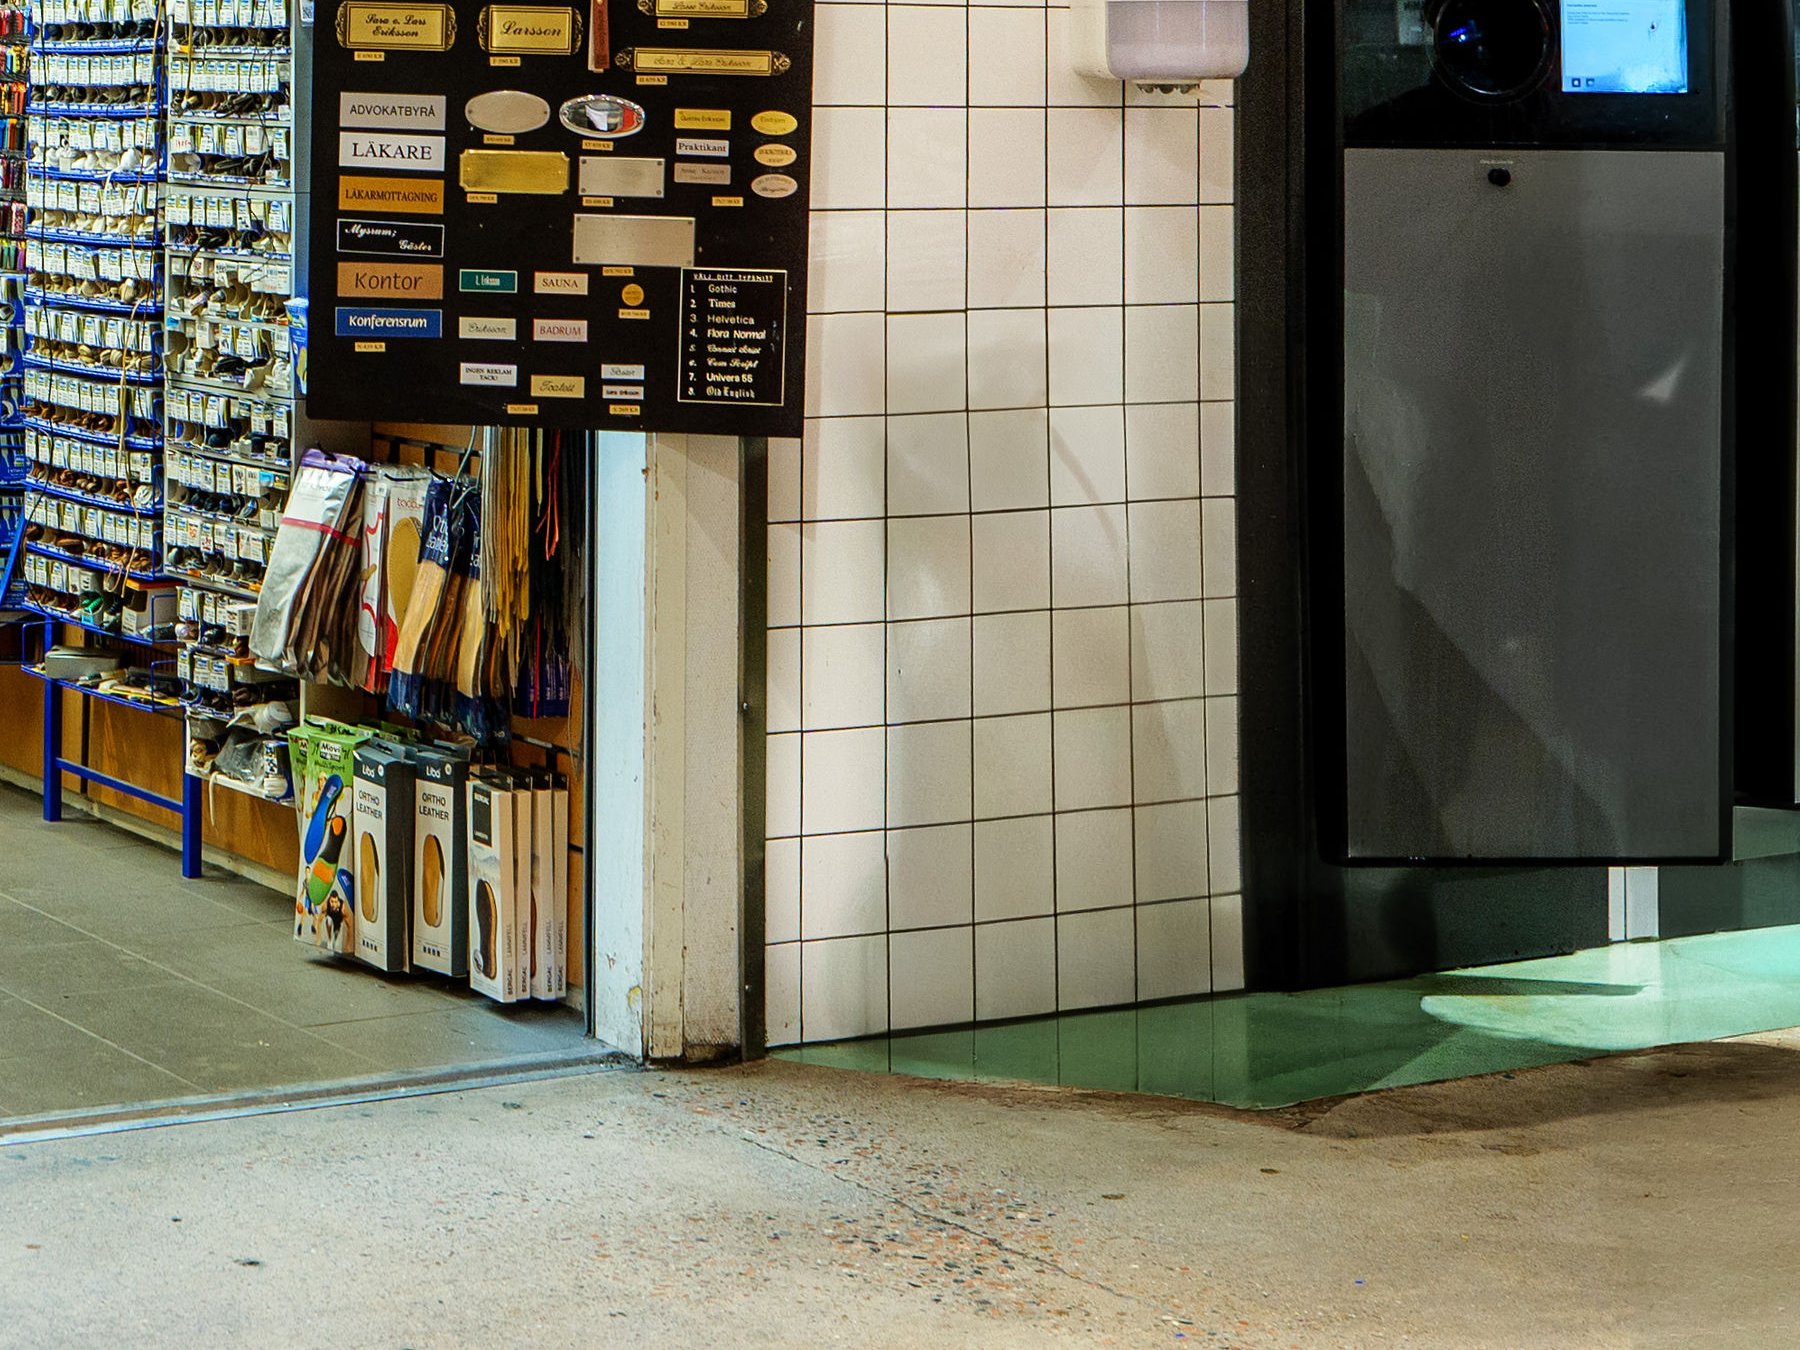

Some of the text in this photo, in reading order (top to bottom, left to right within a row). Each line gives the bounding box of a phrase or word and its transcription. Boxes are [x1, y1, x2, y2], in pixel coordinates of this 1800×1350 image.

[500, 20, 562, 38] Larsson
[349, 104, 436, 118] ADVOKATBYRÅ
[351, 140, 433, 161] LÄKARE
[677, 141, 727, 153] Praktikant
[345, 187, 438, 203] LÄKARMOTTAGNING
[354, 271, 424, 291] Kontor
[541, 278, 579, 289] SAUNA
[708, 283, 738, 294] Gothic
[708, 298, 736, 309] Times
[348, 314, 428, 330] Konferensrum
[707, 314, 755, 325] Helvetica
[539, 325, 582, 337] BADRUM
[707, 328, 730, 339] Flora
[733, 329, 766, 340] Normal
[358, 789, 380, 807] ORTHO
[422, 791, 447, 807] ORTHO
[356, 801, 383, 821] LEATHER
[419, 805, 450, 822] LEATHER
